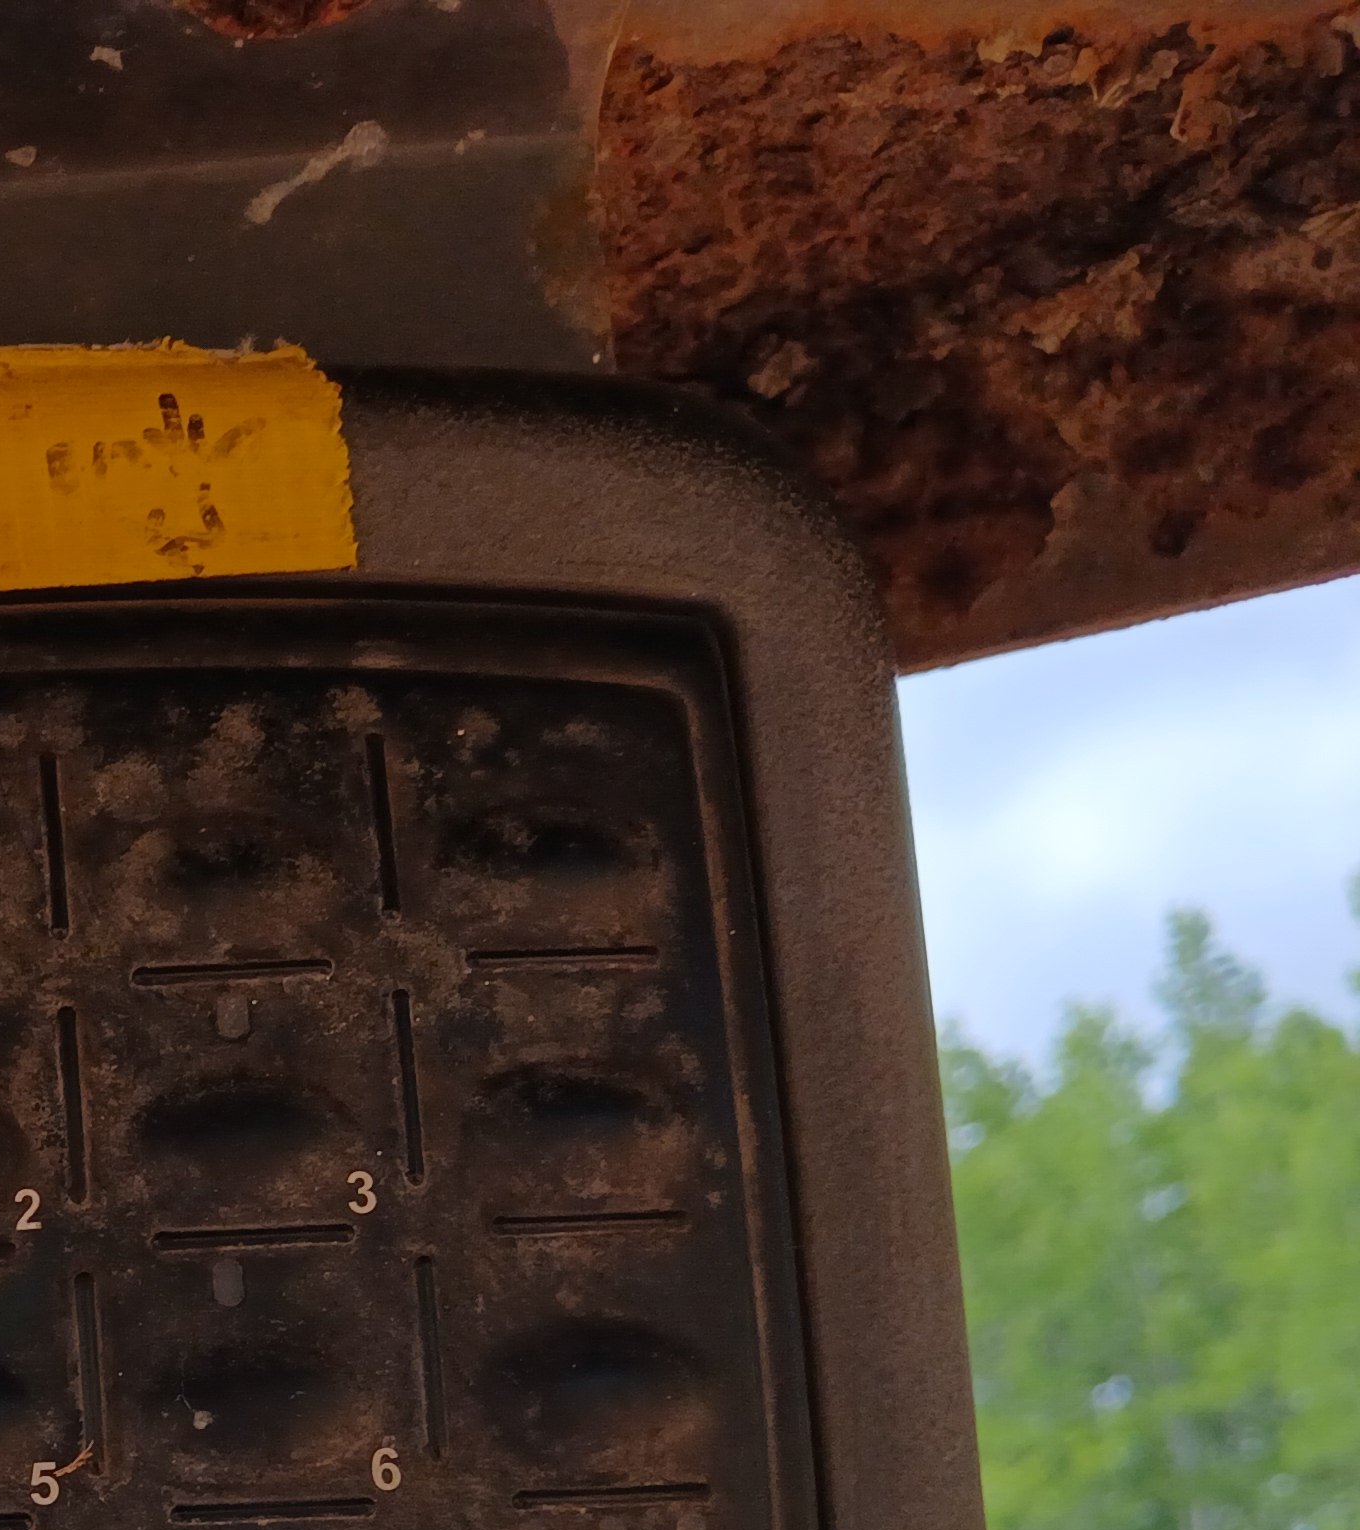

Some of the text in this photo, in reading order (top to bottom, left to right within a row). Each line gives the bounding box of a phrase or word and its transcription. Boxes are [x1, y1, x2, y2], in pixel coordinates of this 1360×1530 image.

[14, 1188, 42, 1230] 2
[347, 1170, 377, 1214] 3
[30, 1461, 59, 1506] 5
[371, 1447, 401, 1491] 6
